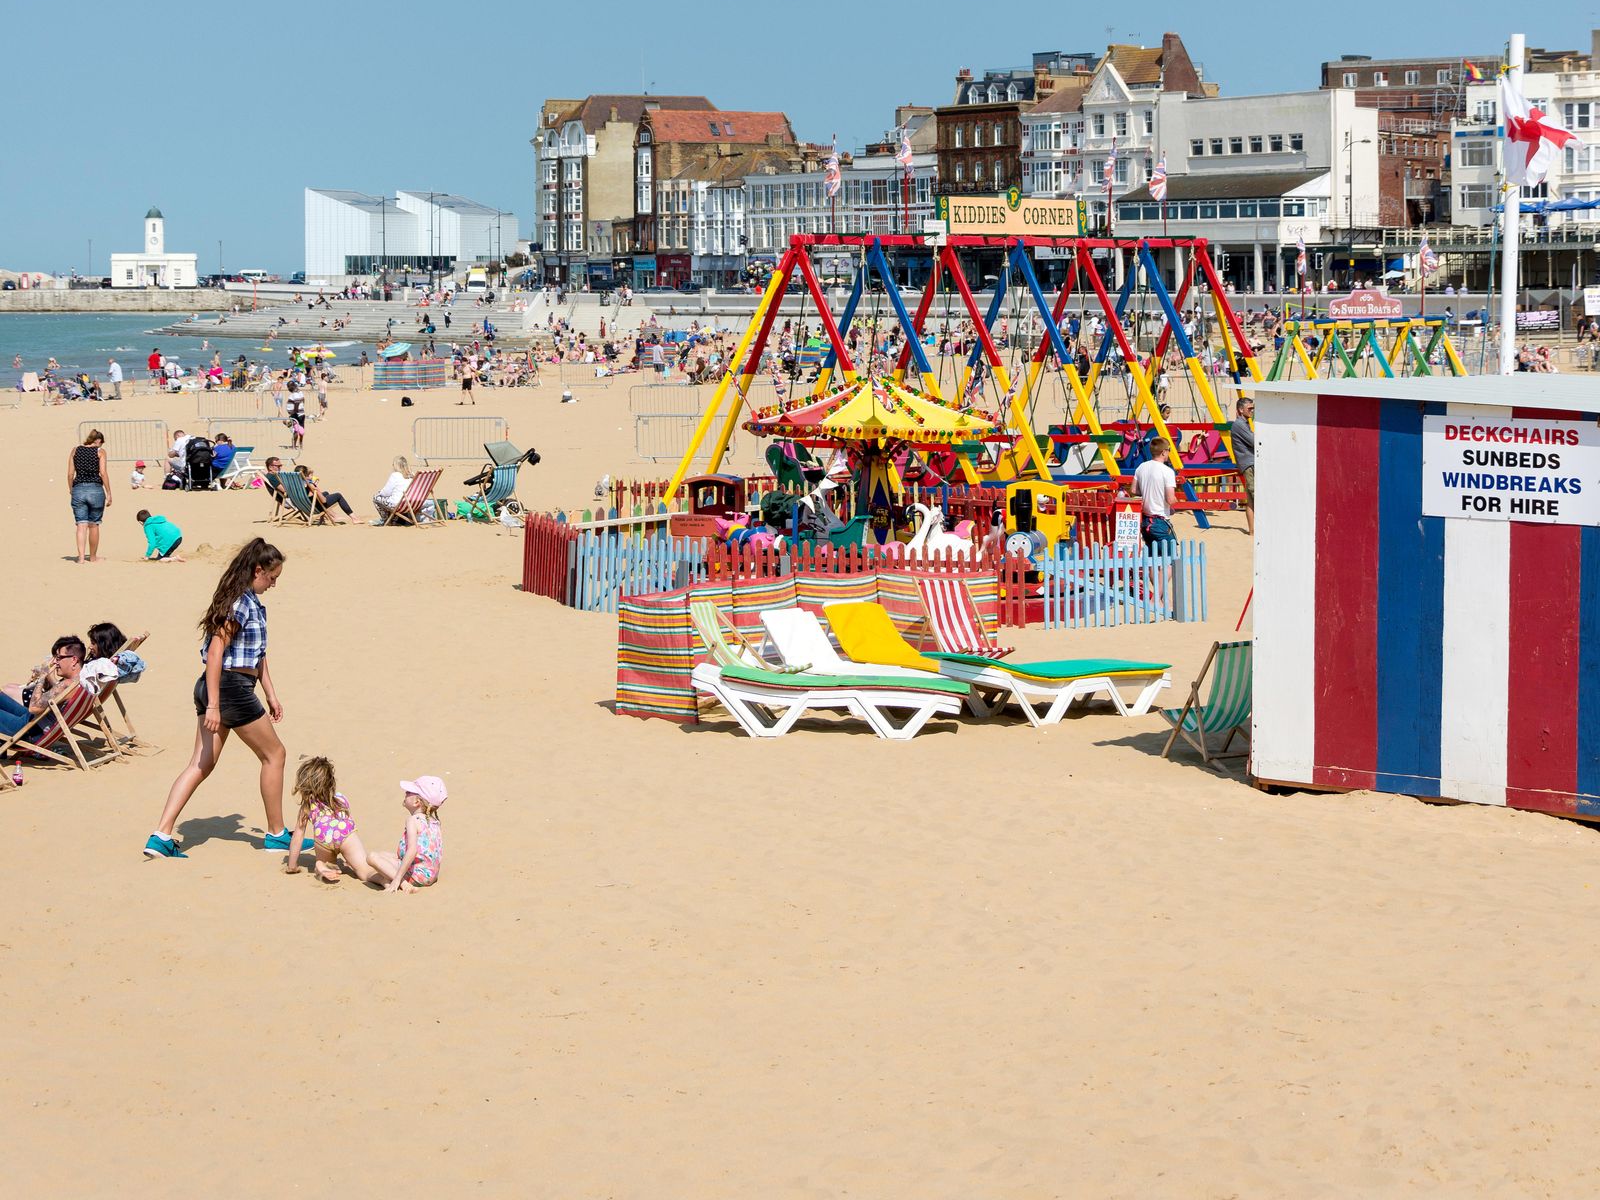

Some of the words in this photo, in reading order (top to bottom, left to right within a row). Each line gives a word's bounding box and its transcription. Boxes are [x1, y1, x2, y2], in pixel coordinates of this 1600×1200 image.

[953, 205, 1006, 224] KIDDIES
[1023, 207, 1074, 225] CORNER
[1445, 424, 1579, 446] DECKCHAIRS
[1462, 449, 1561, 470] SUNBEDS
[1442, 471, 1582, 495] WINDBREAKS
[1461, 495, 1501, 512] FOR
[1510, 498, 1559, 516] HIRE
[1118, 520, 1138, 528] £1.50
